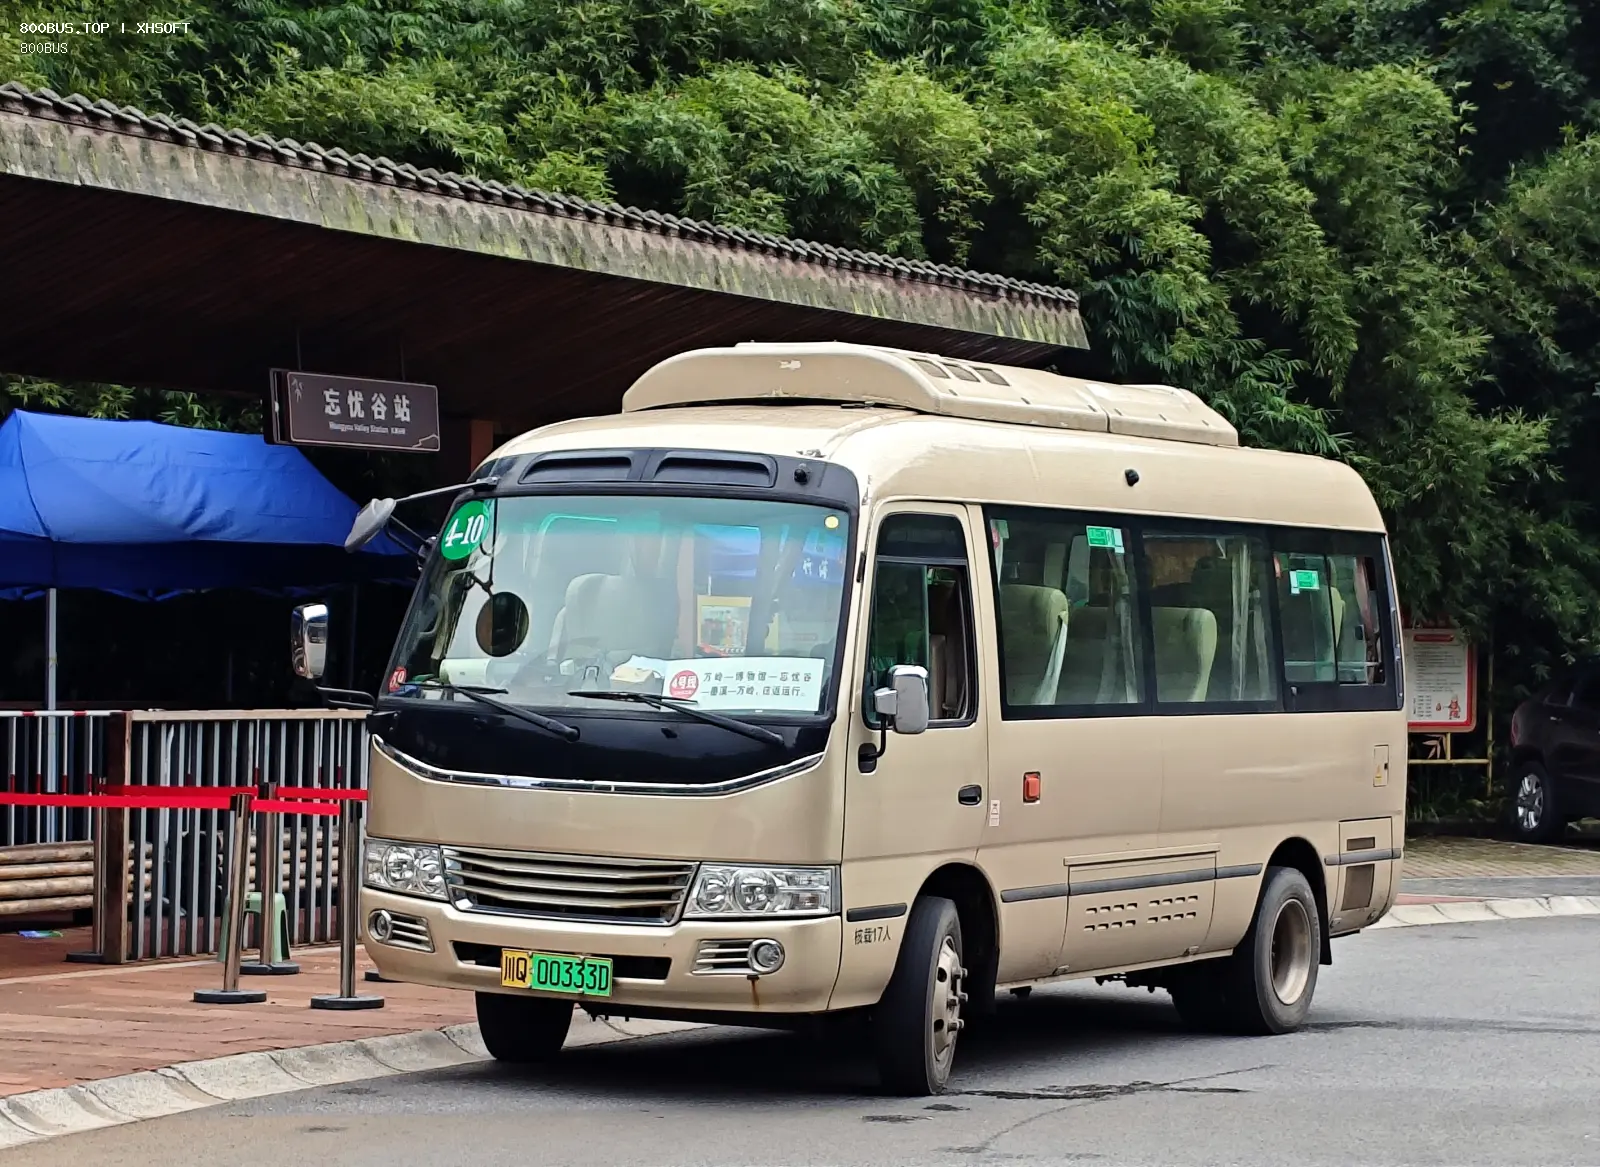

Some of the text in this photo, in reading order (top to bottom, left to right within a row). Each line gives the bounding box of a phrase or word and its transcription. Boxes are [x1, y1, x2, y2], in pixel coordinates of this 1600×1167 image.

[323, 388, 411, 422] 忘忧谷站
[445, 514, 485, 547] 4-10
